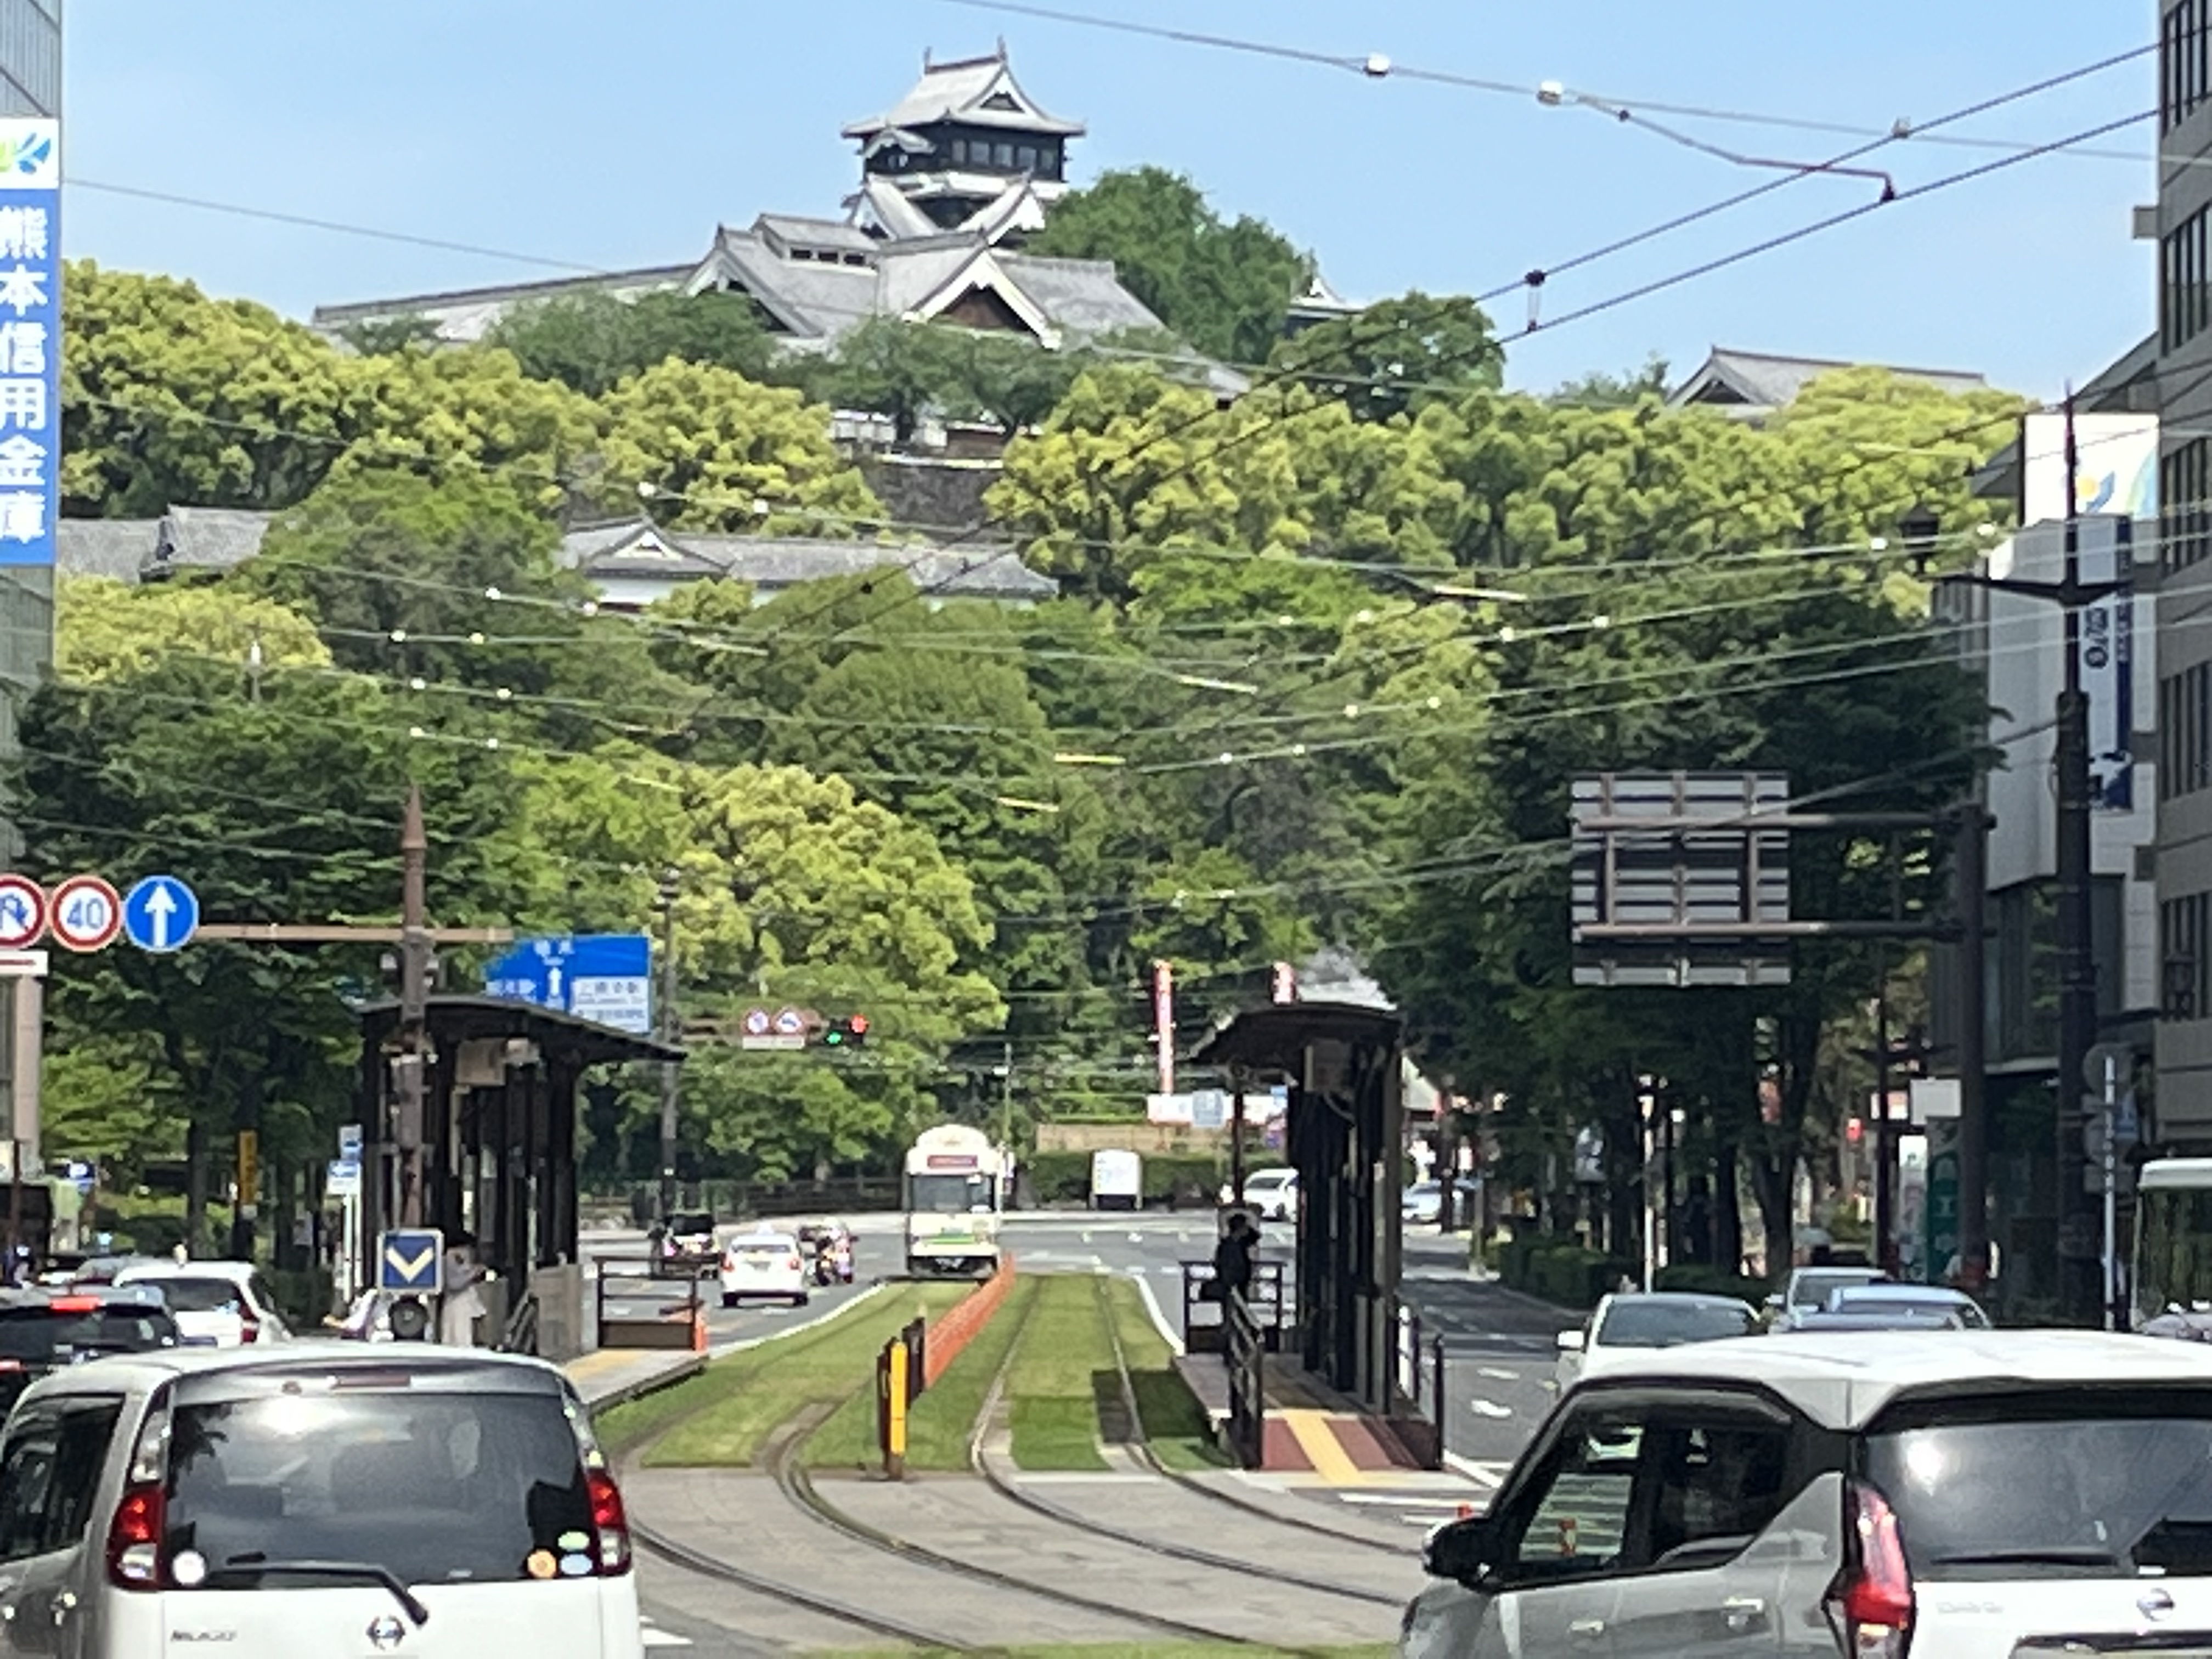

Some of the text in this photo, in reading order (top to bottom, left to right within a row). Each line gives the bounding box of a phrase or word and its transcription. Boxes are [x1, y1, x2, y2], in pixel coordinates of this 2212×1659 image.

[0, 205, 48, 544] 熊本信用金庫
[67, 898, 104, 929] 40
